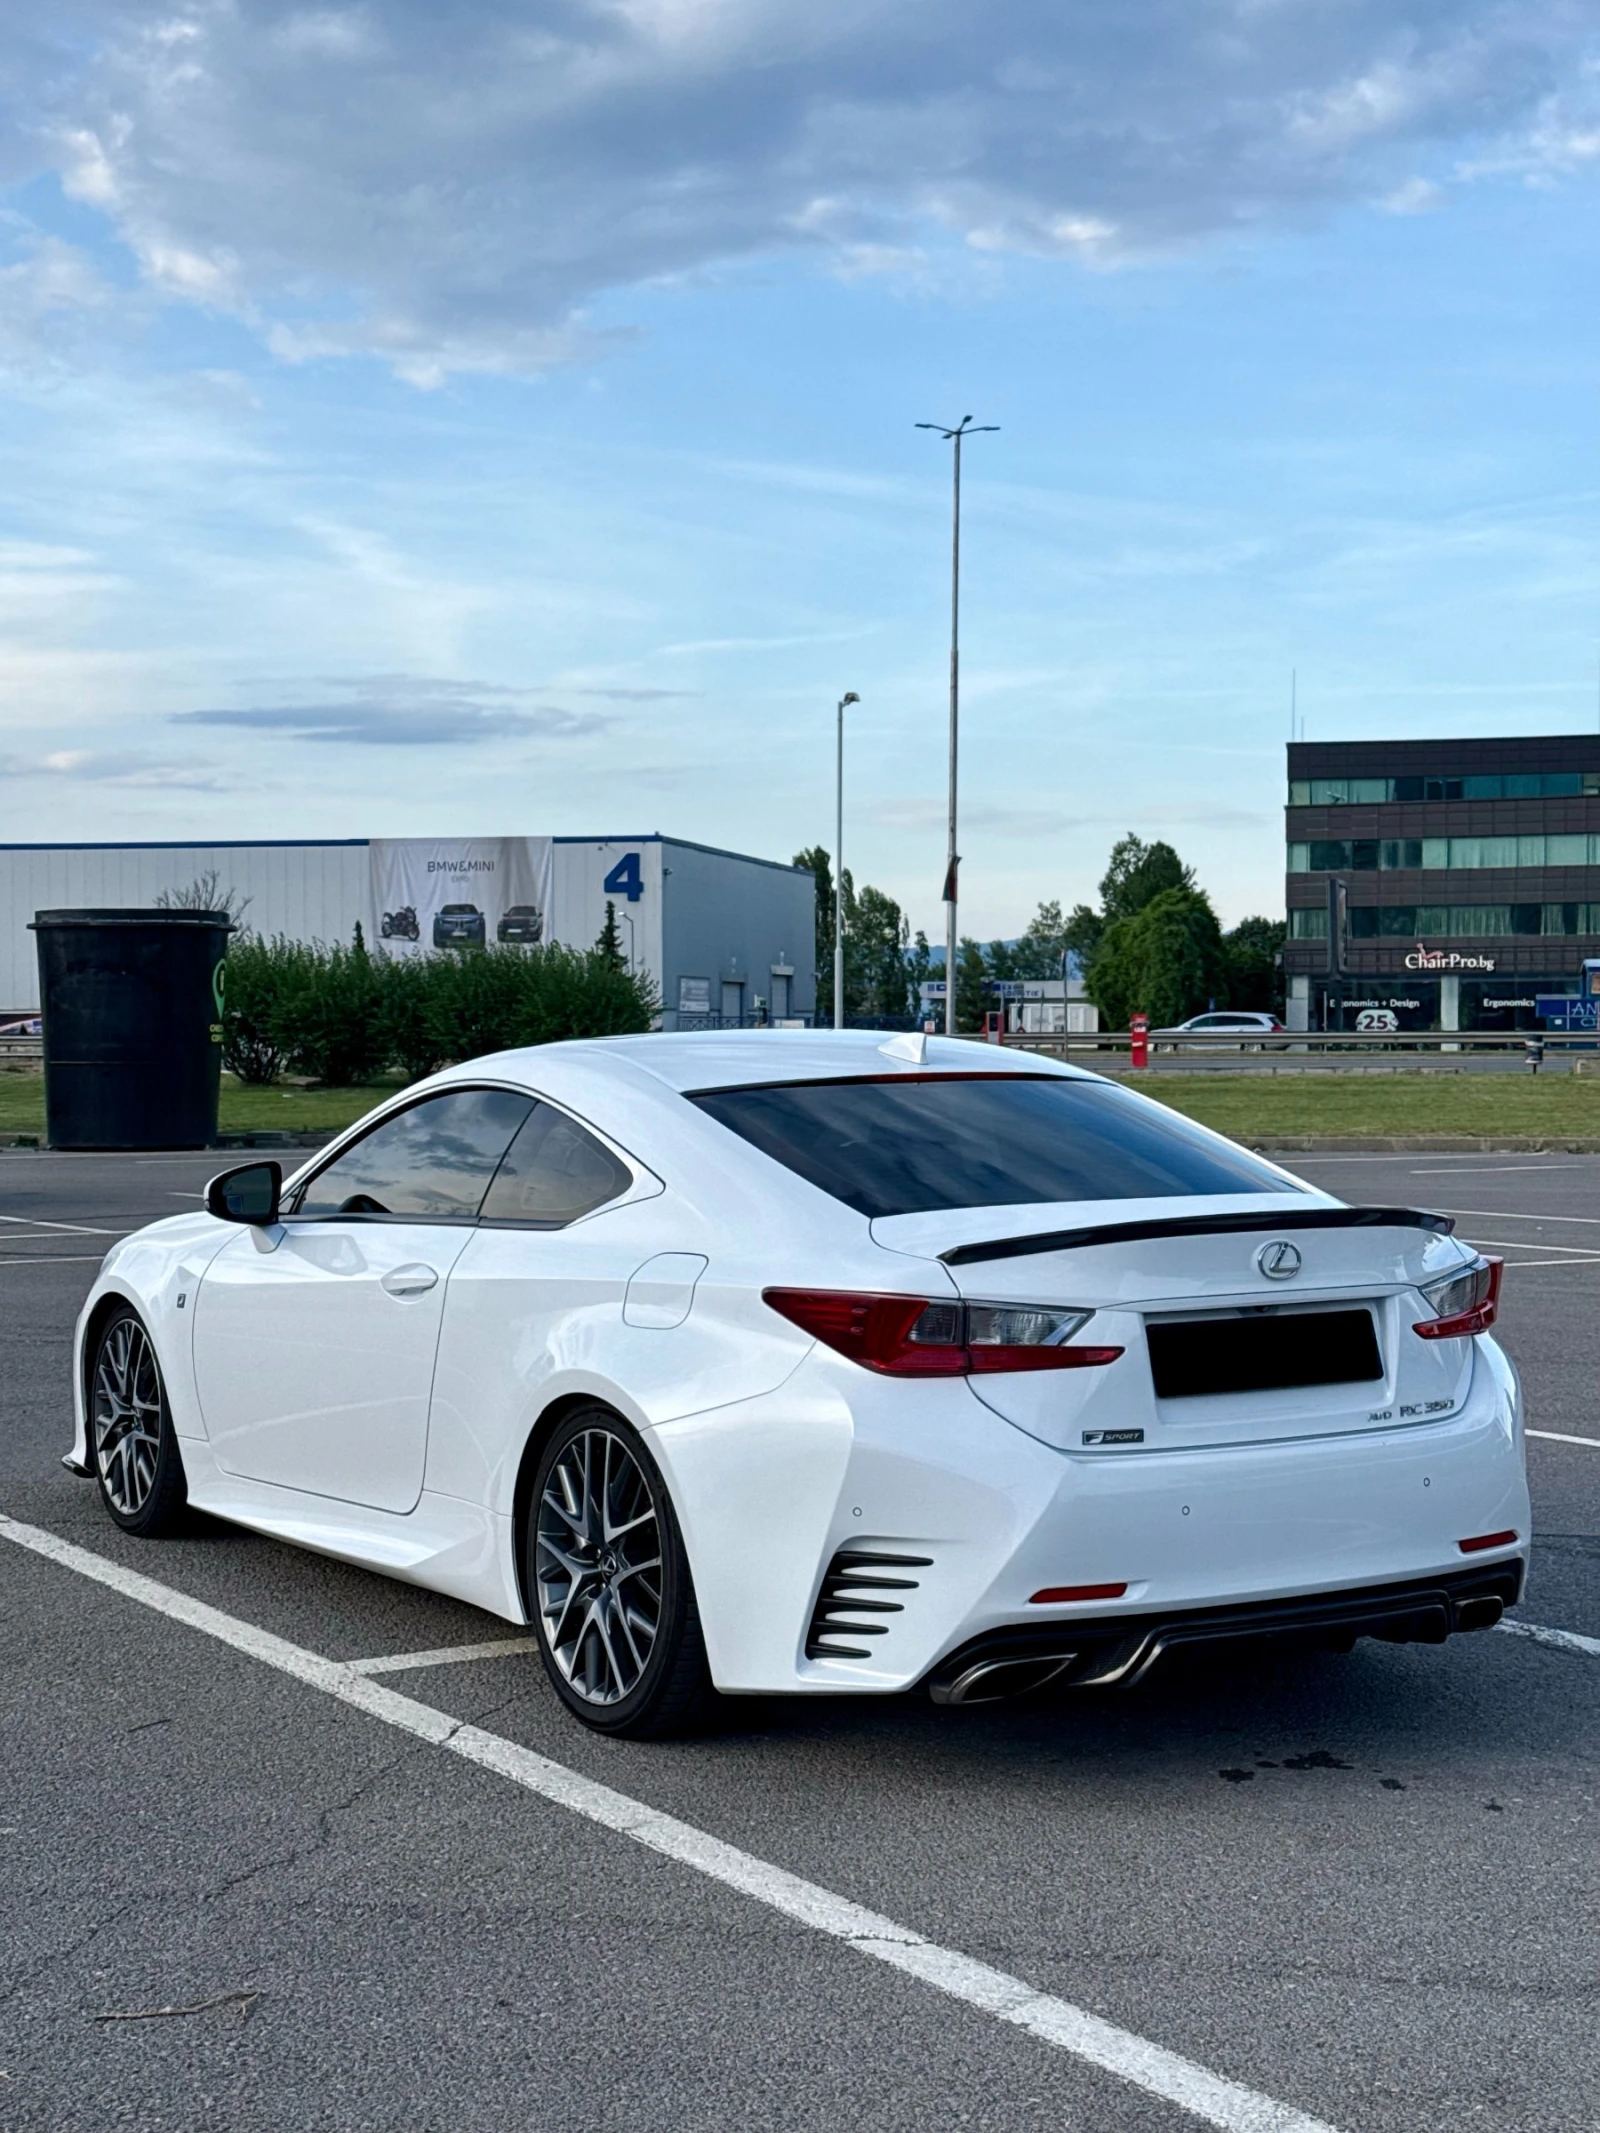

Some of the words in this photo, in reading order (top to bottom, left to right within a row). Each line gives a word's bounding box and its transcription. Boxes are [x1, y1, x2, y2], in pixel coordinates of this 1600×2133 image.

[604, 853, 644, 902] 4
[1405, 953, 1495, 972] ChairPro.bg
[1390, 999, 1420, 1009] Design
[1483, 998, 1535, 1009] Ergonomics
[1363, 1014, 1388, 1030] 25
[1367, 1411, 1392, 1422] AWD
[1399, 1403, 1423, 1417] RC
[1424, 1399, 1455, 1414] 350
[1104, 1432, 1140, 1441] SPORT
